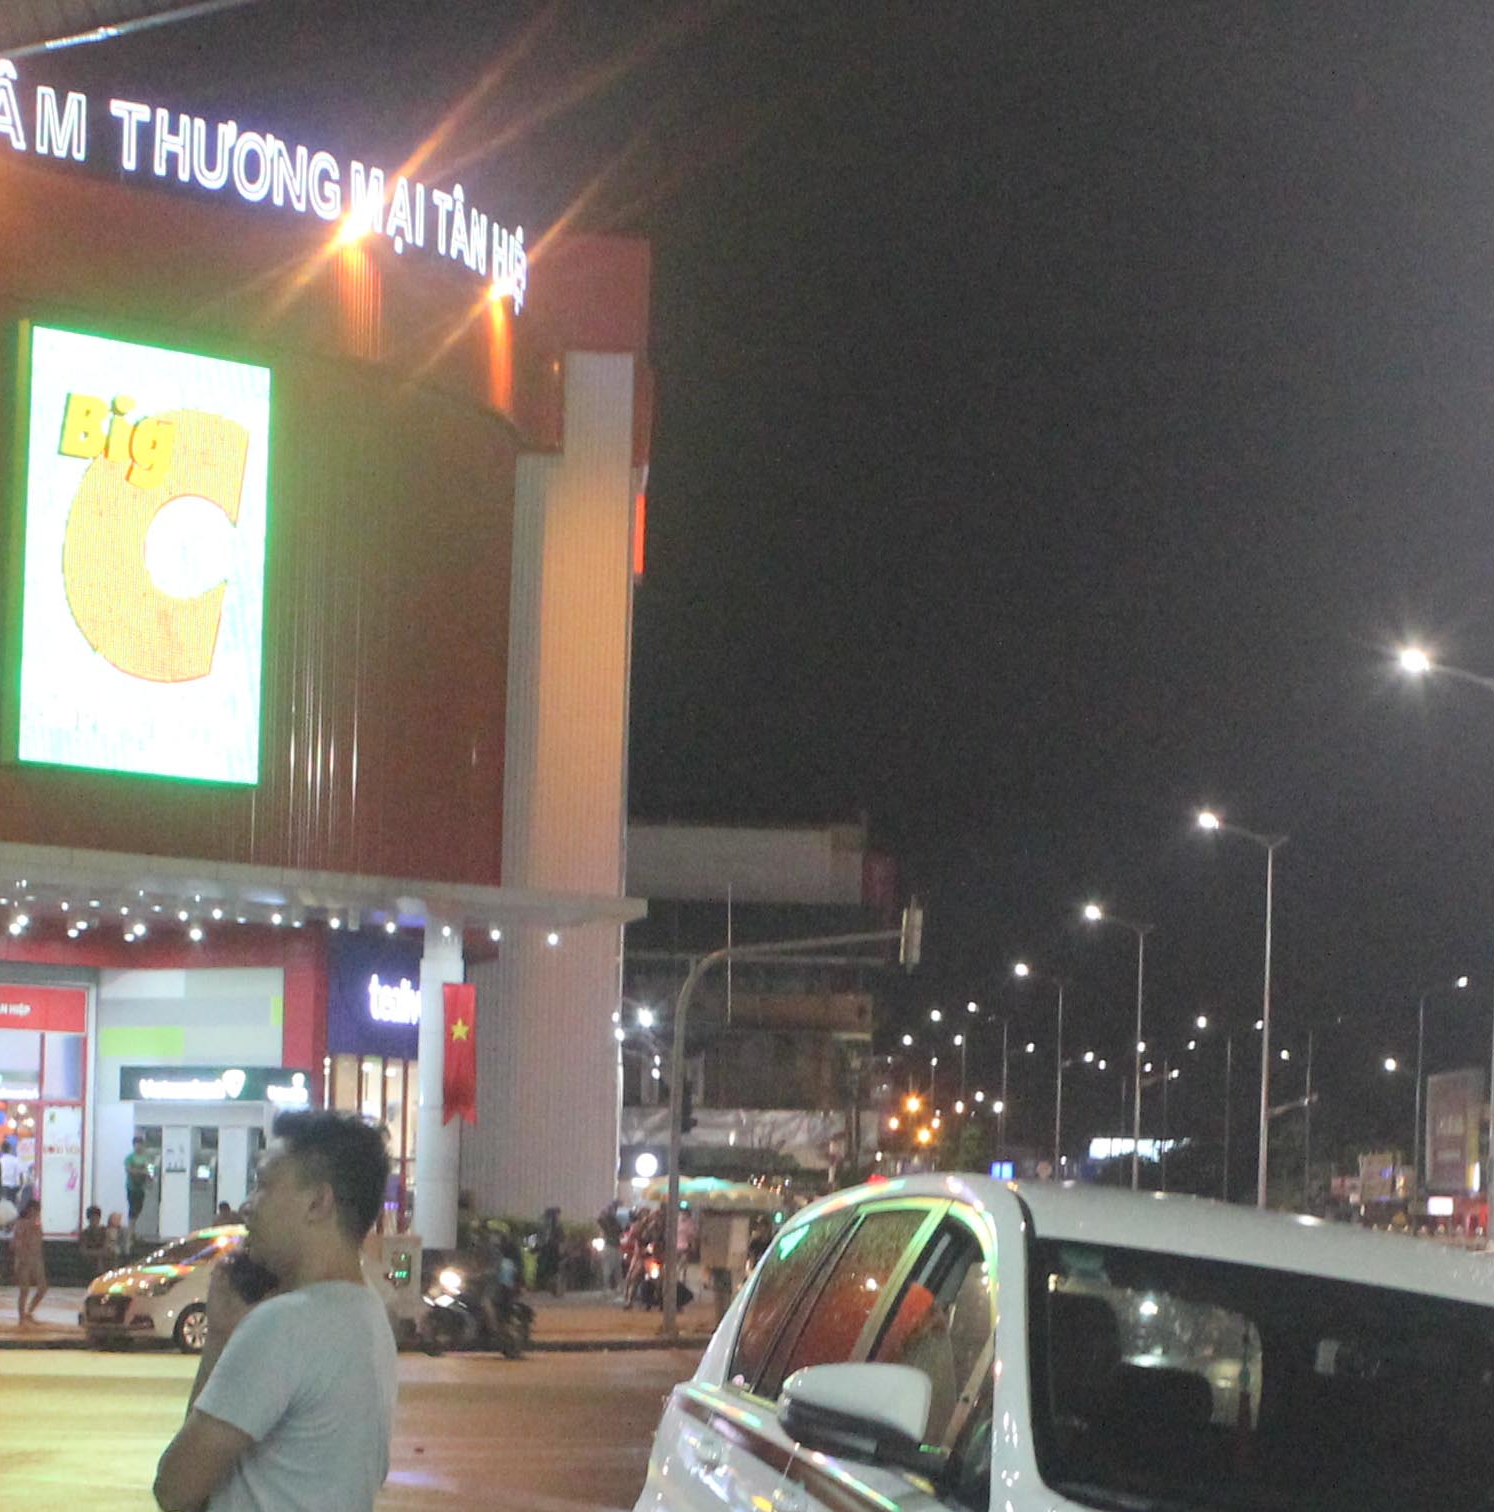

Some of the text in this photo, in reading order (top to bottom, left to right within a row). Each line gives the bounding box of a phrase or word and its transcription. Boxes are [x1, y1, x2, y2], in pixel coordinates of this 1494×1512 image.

[109, 99, 342, 221] THƯƠNG
[349, 160, 426, 254] MẠI
[433, 184, 488, 276] TÂN
[59, 393, 250, 683] Big C
